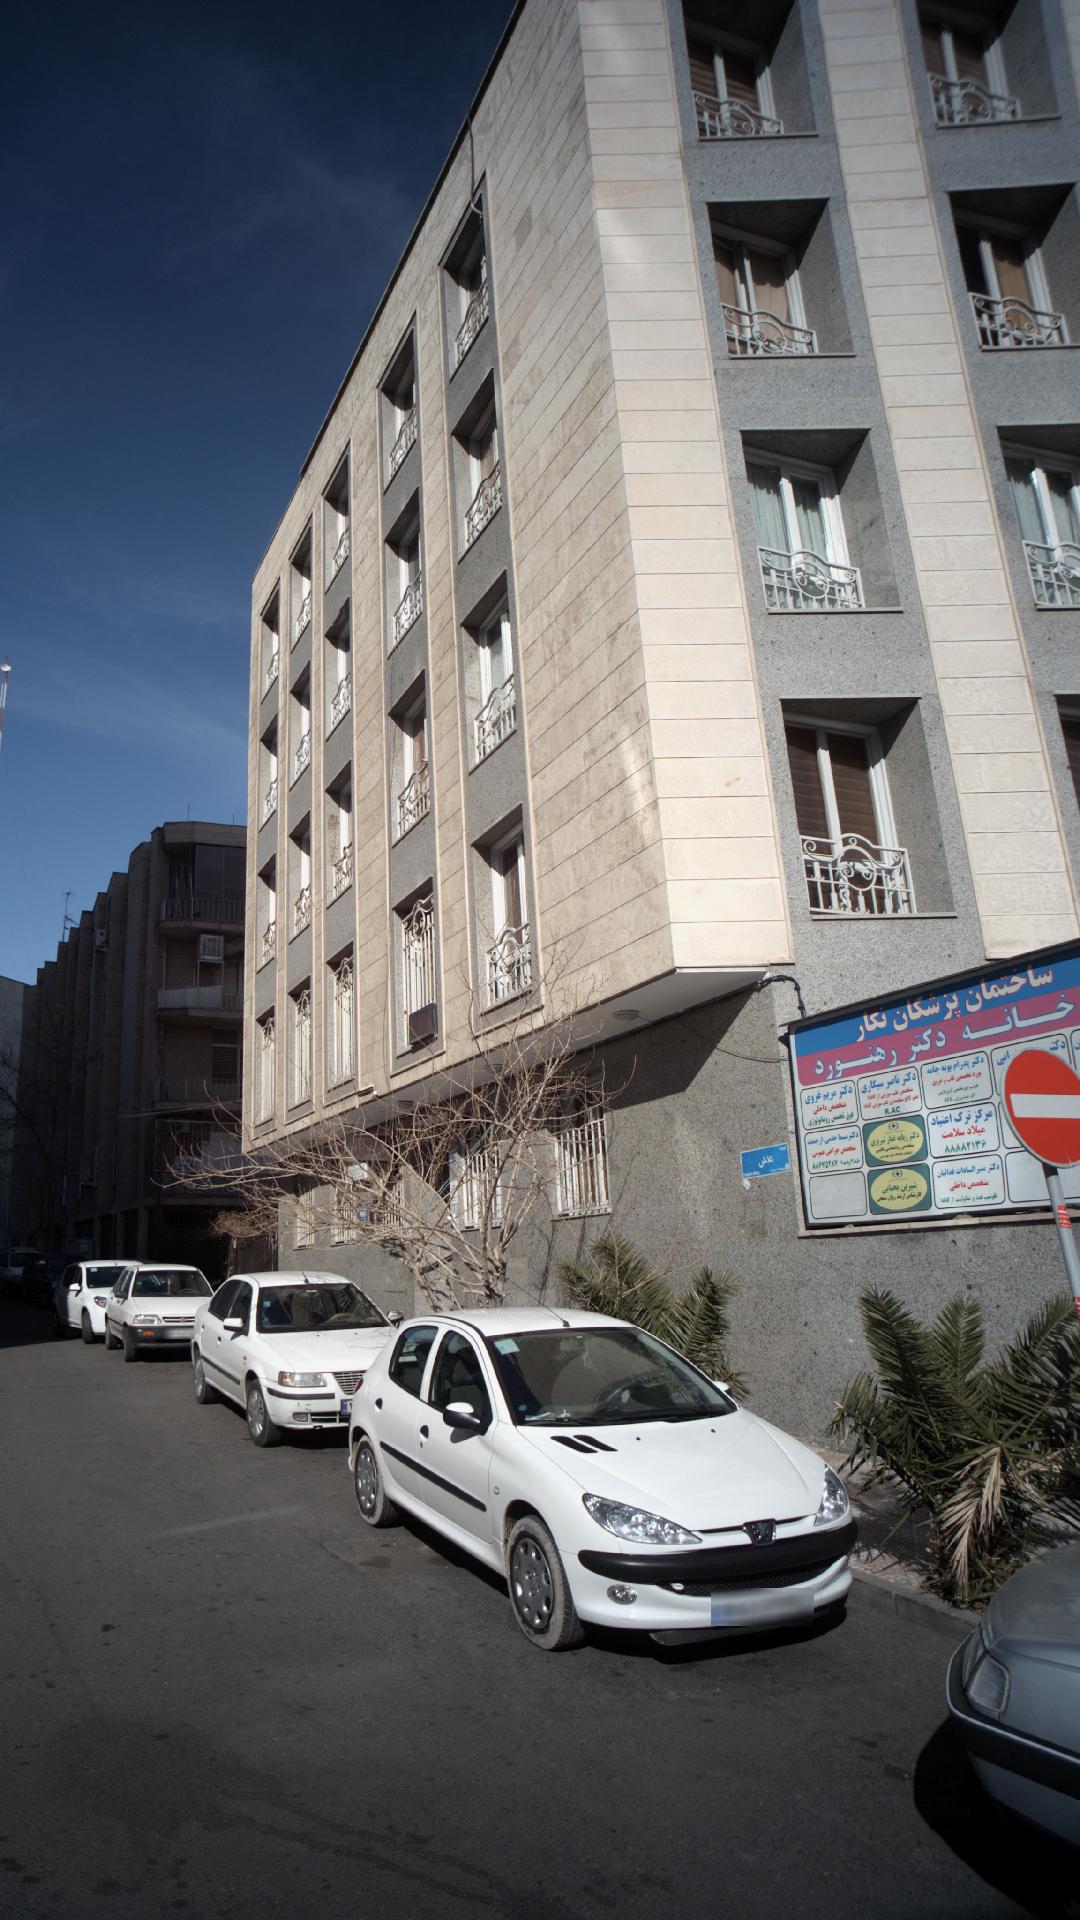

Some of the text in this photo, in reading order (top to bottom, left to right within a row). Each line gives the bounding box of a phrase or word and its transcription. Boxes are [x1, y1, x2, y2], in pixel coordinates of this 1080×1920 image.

[856, 966, 1054, 1042] ساختمان پزشکان نگار
[815, 993, 1075, 1080] خانه دکتر رهنورد
[972, 1055, 984, 1068] دکتر
[902, 1071, 917, 1087] دکتر
[839, 1085, 853, 1099] دکتر
[931, 1108, 993, 1127] مرکز ترک اعتیاد
[988, 1162, 1000, 1173] دکتر
